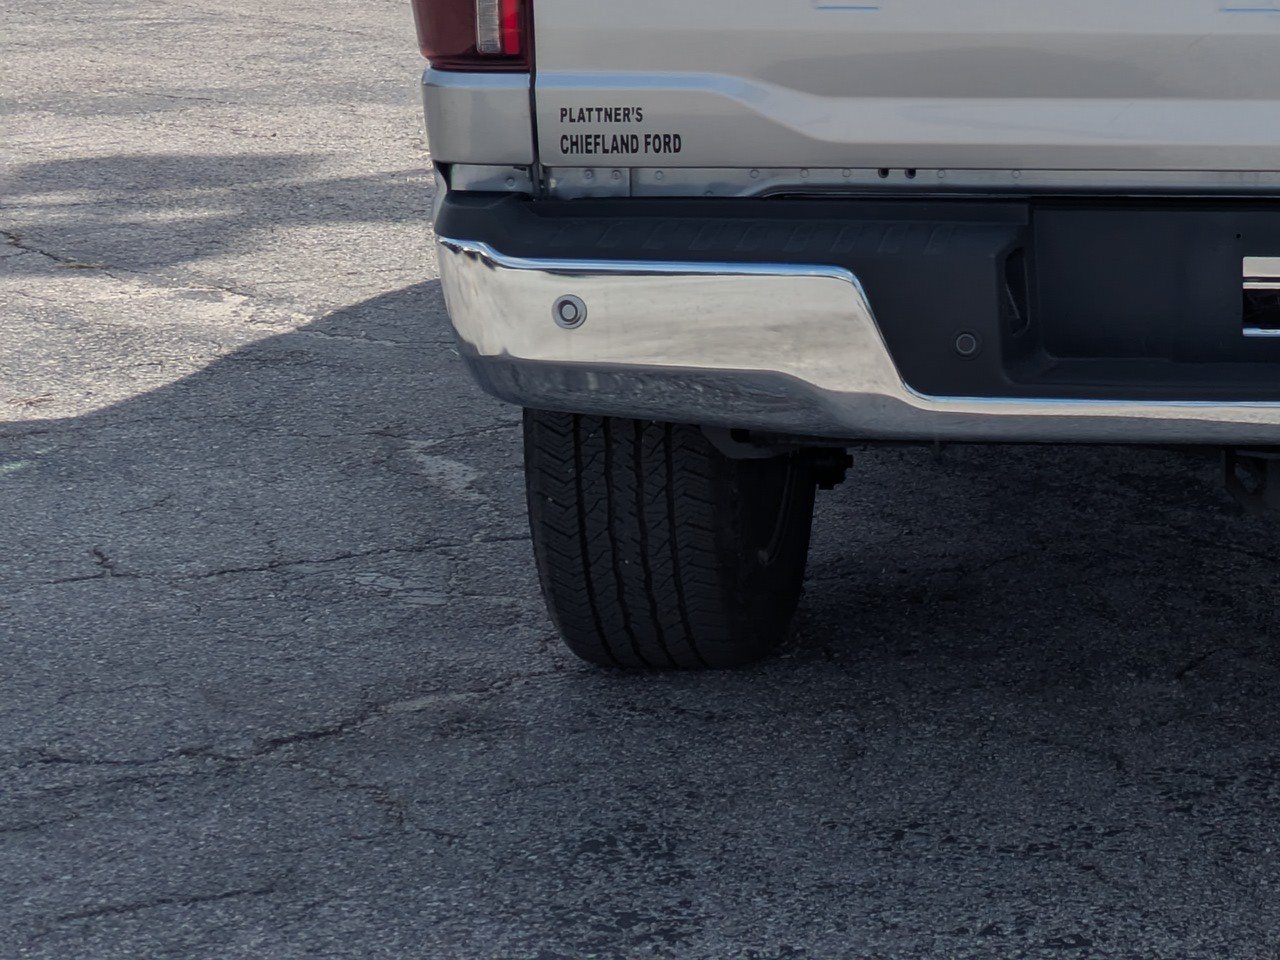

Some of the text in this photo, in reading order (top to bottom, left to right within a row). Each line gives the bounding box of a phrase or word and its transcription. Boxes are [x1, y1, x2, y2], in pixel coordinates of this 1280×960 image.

[560, 107, 643, 123] PLATTNER'S
[560, 133, 682, 154] CHIEFLAND FORD
